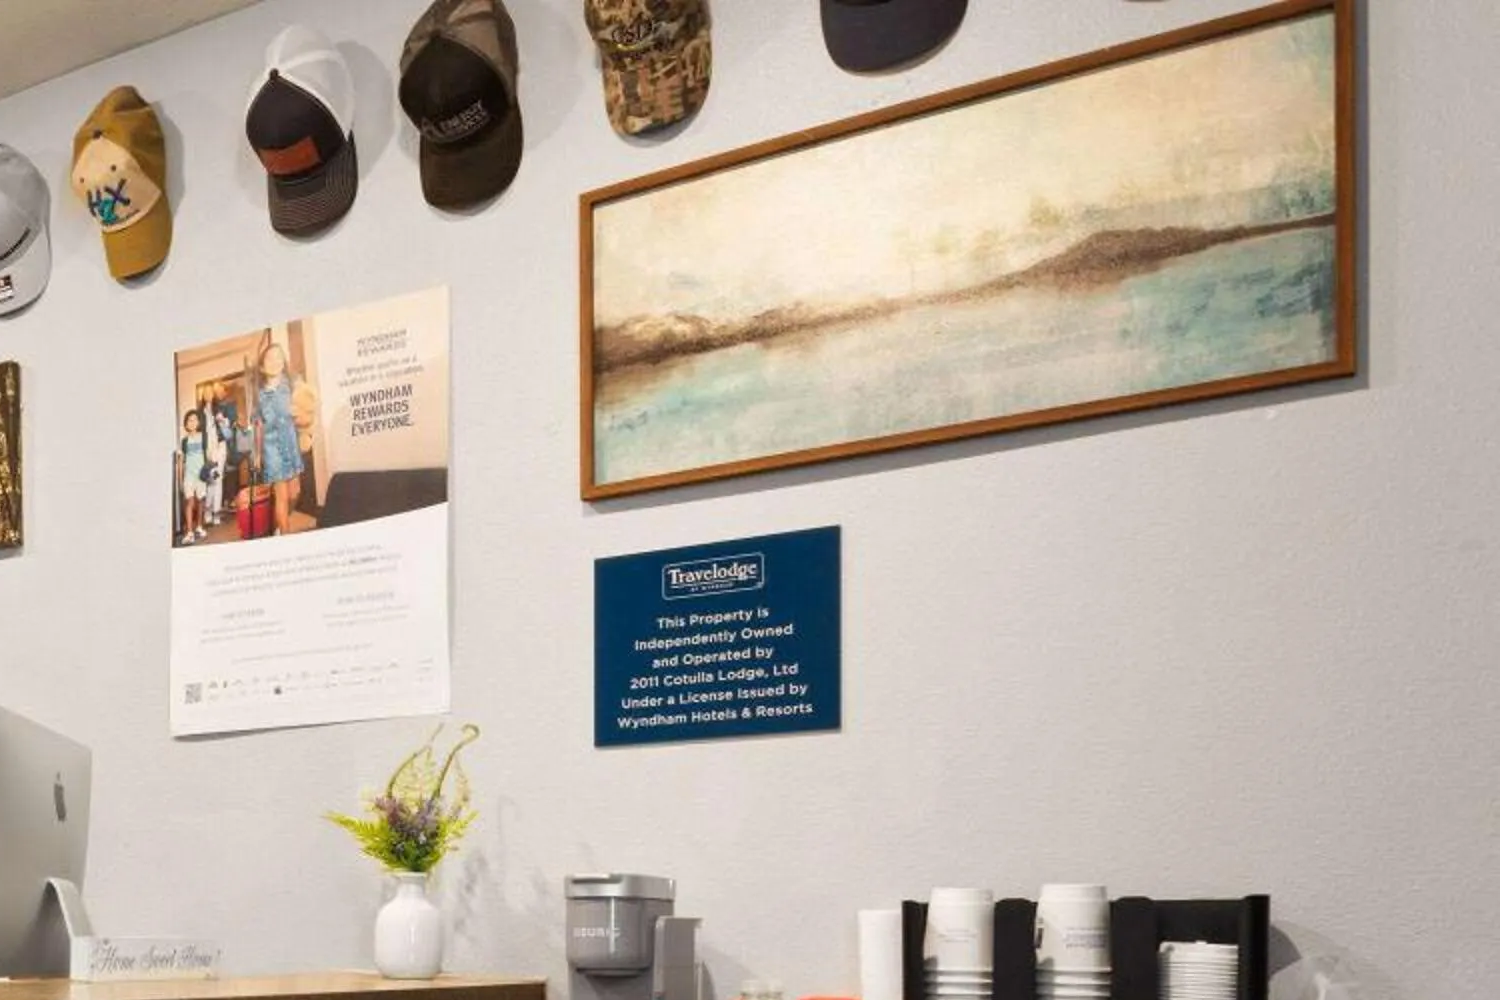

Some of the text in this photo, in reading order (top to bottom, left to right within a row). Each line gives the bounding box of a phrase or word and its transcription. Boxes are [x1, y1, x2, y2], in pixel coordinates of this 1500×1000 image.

[349, 383, 413, 407] WYNDHAM
[353, 399, 409, 421] REWARDS
[667, 562, 758, 585] Travelodge
[657, 615, 685, 629] This
[690, 609, 752, 626] Property
[634, 623, 794, 651] Independently Owned
[652, 646, 773, 668] and Operated by
[630, 662, 799, 690] 2011 Cotulla Lodge, Ltd
[621, 695, 663, 709] Under
[667, 694, 675, 705] a
[679, 688, 733, 705] License
[789, 681, 809, 696] by
[617, 702, 813, 729] Wyndham Hotels & Resorts
